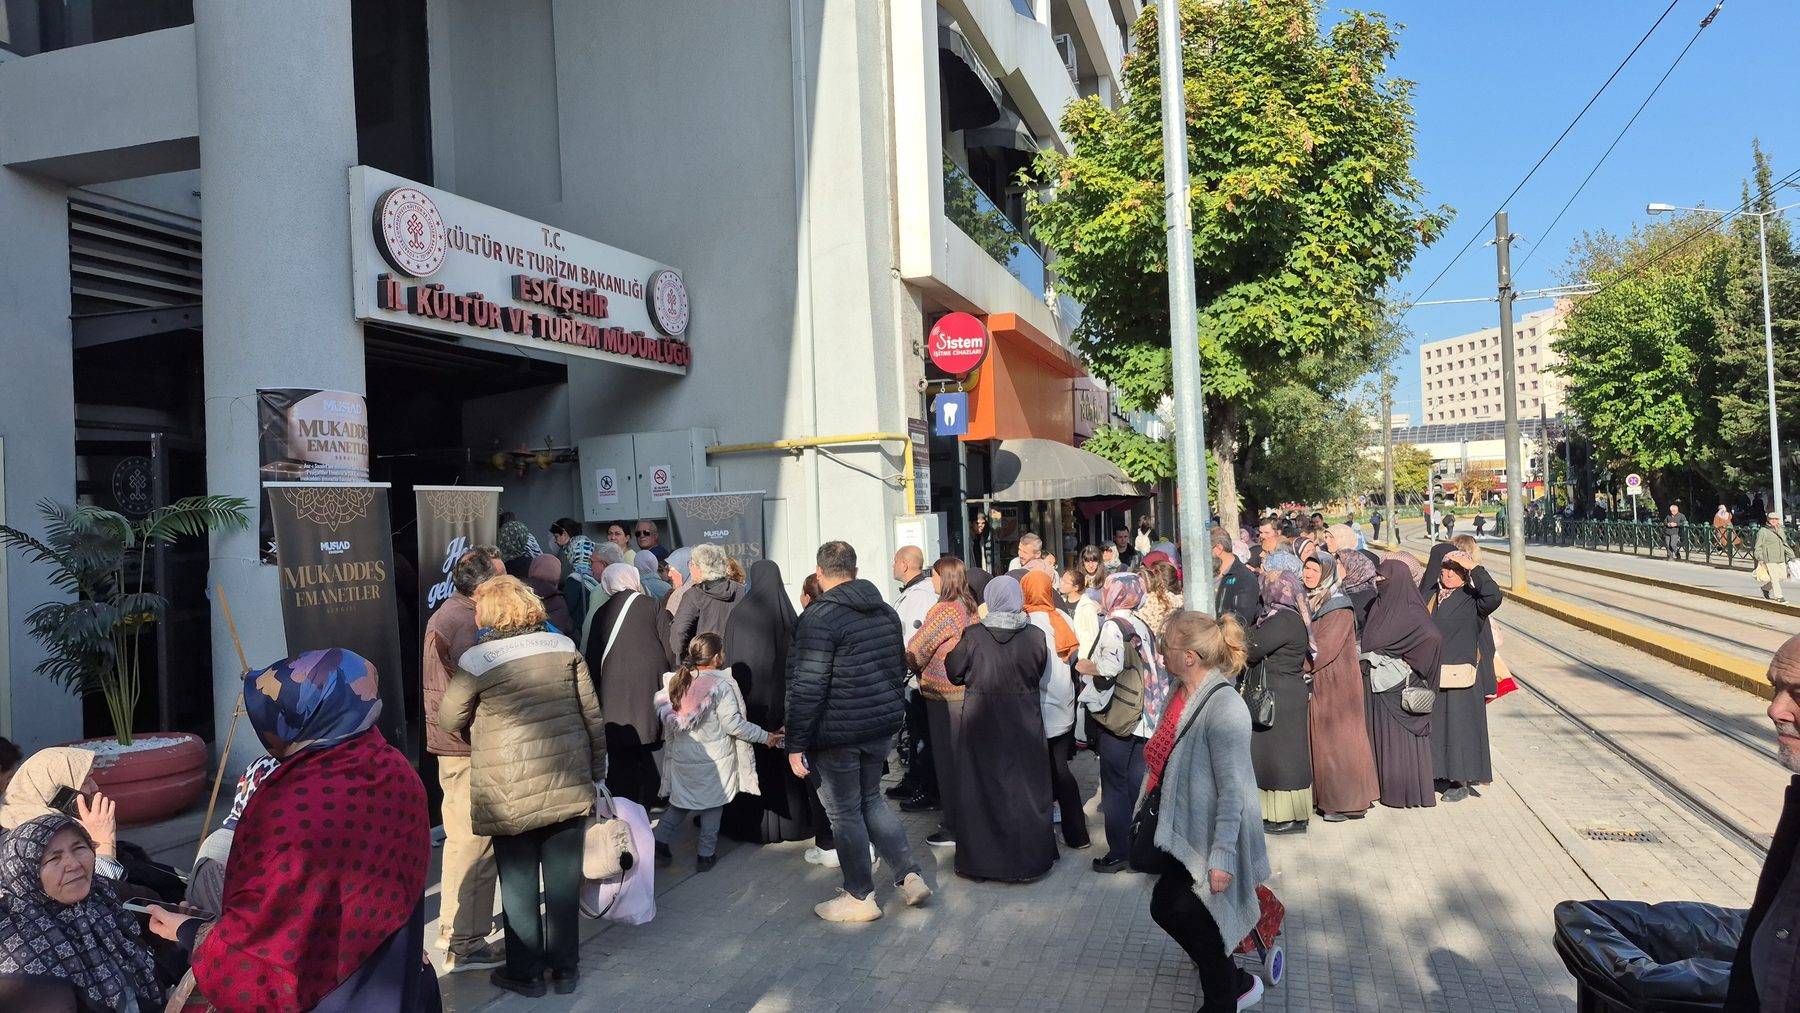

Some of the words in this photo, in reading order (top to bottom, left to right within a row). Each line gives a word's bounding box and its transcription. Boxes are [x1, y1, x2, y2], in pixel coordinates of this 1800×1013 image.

[541, 228, 565, 252] T.C.
[446, 225, 503, 262] KÜLTÜR
[505, 245, 524, 268] VE
[527, 250, 578, 283] TURİZM
[581, 267, 643, 300] BAKANLIĞI
[514, 274, 609, 318] ESKİŞEHİR
[380, 272, 407, 311] İL
[410, 283, 501, 329] KÜLTÜR
[503, 306, 533, 336] VE
[534, 312, 600, 349] TURİZM
[601, 326, 692, 367] MÜDÜRLÜĞÜ
[936, 333, 983, 350] Sistem
[284, 559, 386, 590] MUKADDES
[295, 584, 380, 608] EMANETLER
